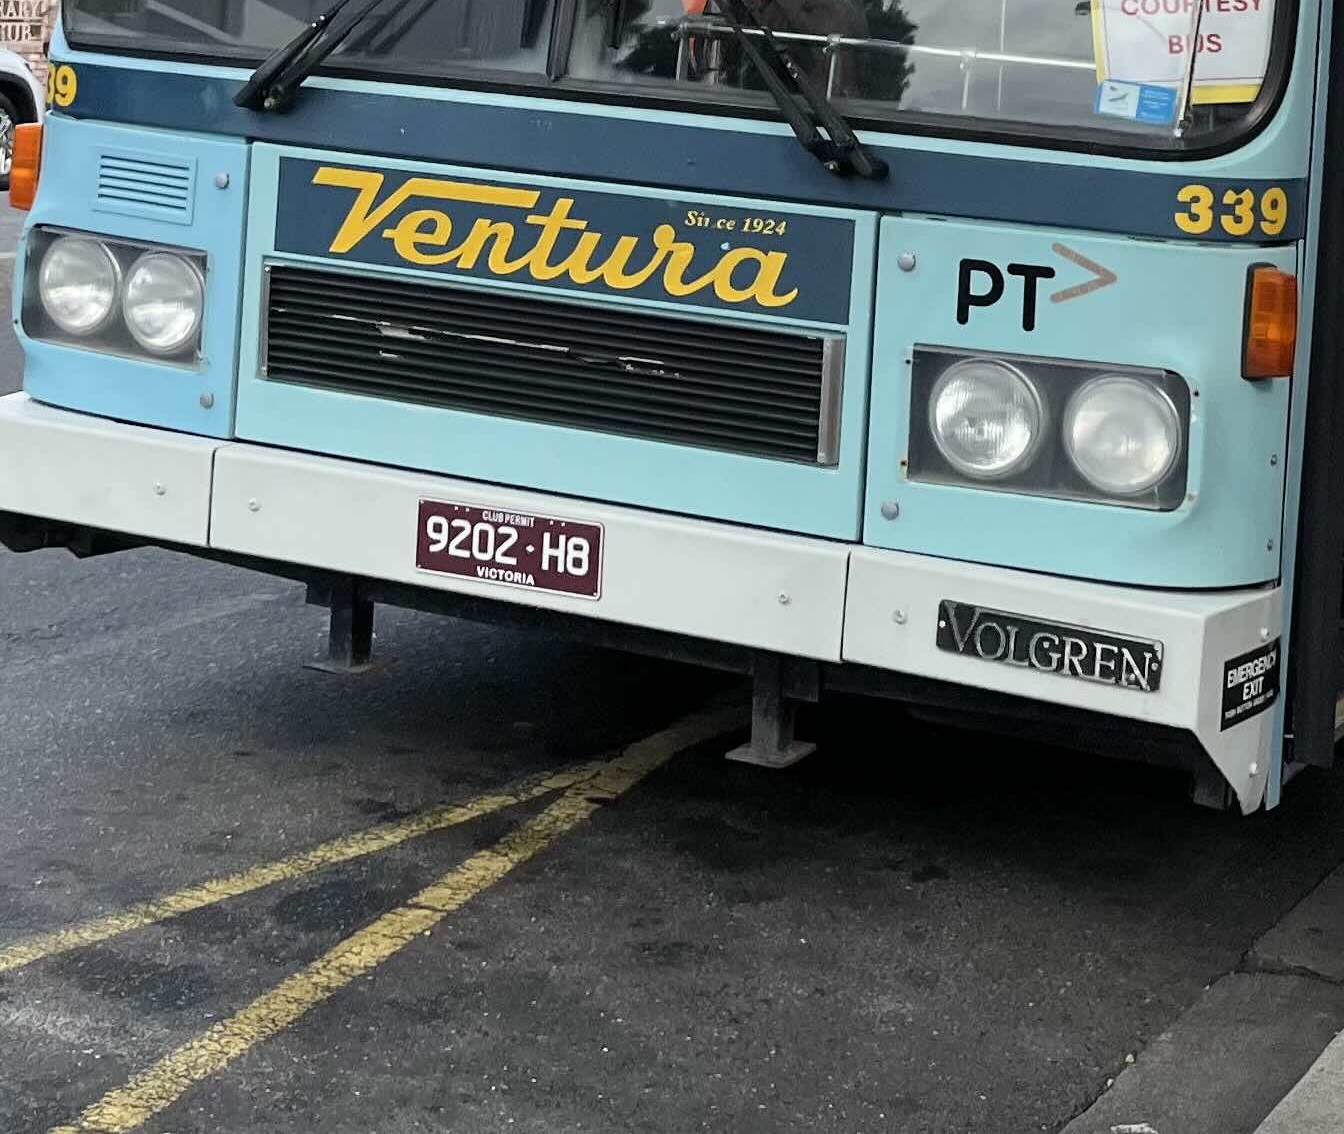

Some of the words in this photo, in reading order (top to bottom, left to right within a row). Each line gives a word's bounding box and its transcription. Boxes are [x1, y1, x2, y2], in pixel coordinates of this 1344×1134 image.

[1168, 33, 1222, 54] BUS
[741, 217, 787, 236] 1924
[1174, 184, 1289, 236] 339
[311, 166, 799, 308] Ventura
[955, 258, 1056, 332] PT
[482, 510, 504, 524] CLUB
[505, 512, 535, 528] PERMIT
[426, 514, 519, 566] 9202
[541, 531, 590, 577] H8
[476, 565, 536, 586] VICTORIA
[943, 601, 1162, 693] VOLGREN
[1242, 676, 1265, 701] EXIT
